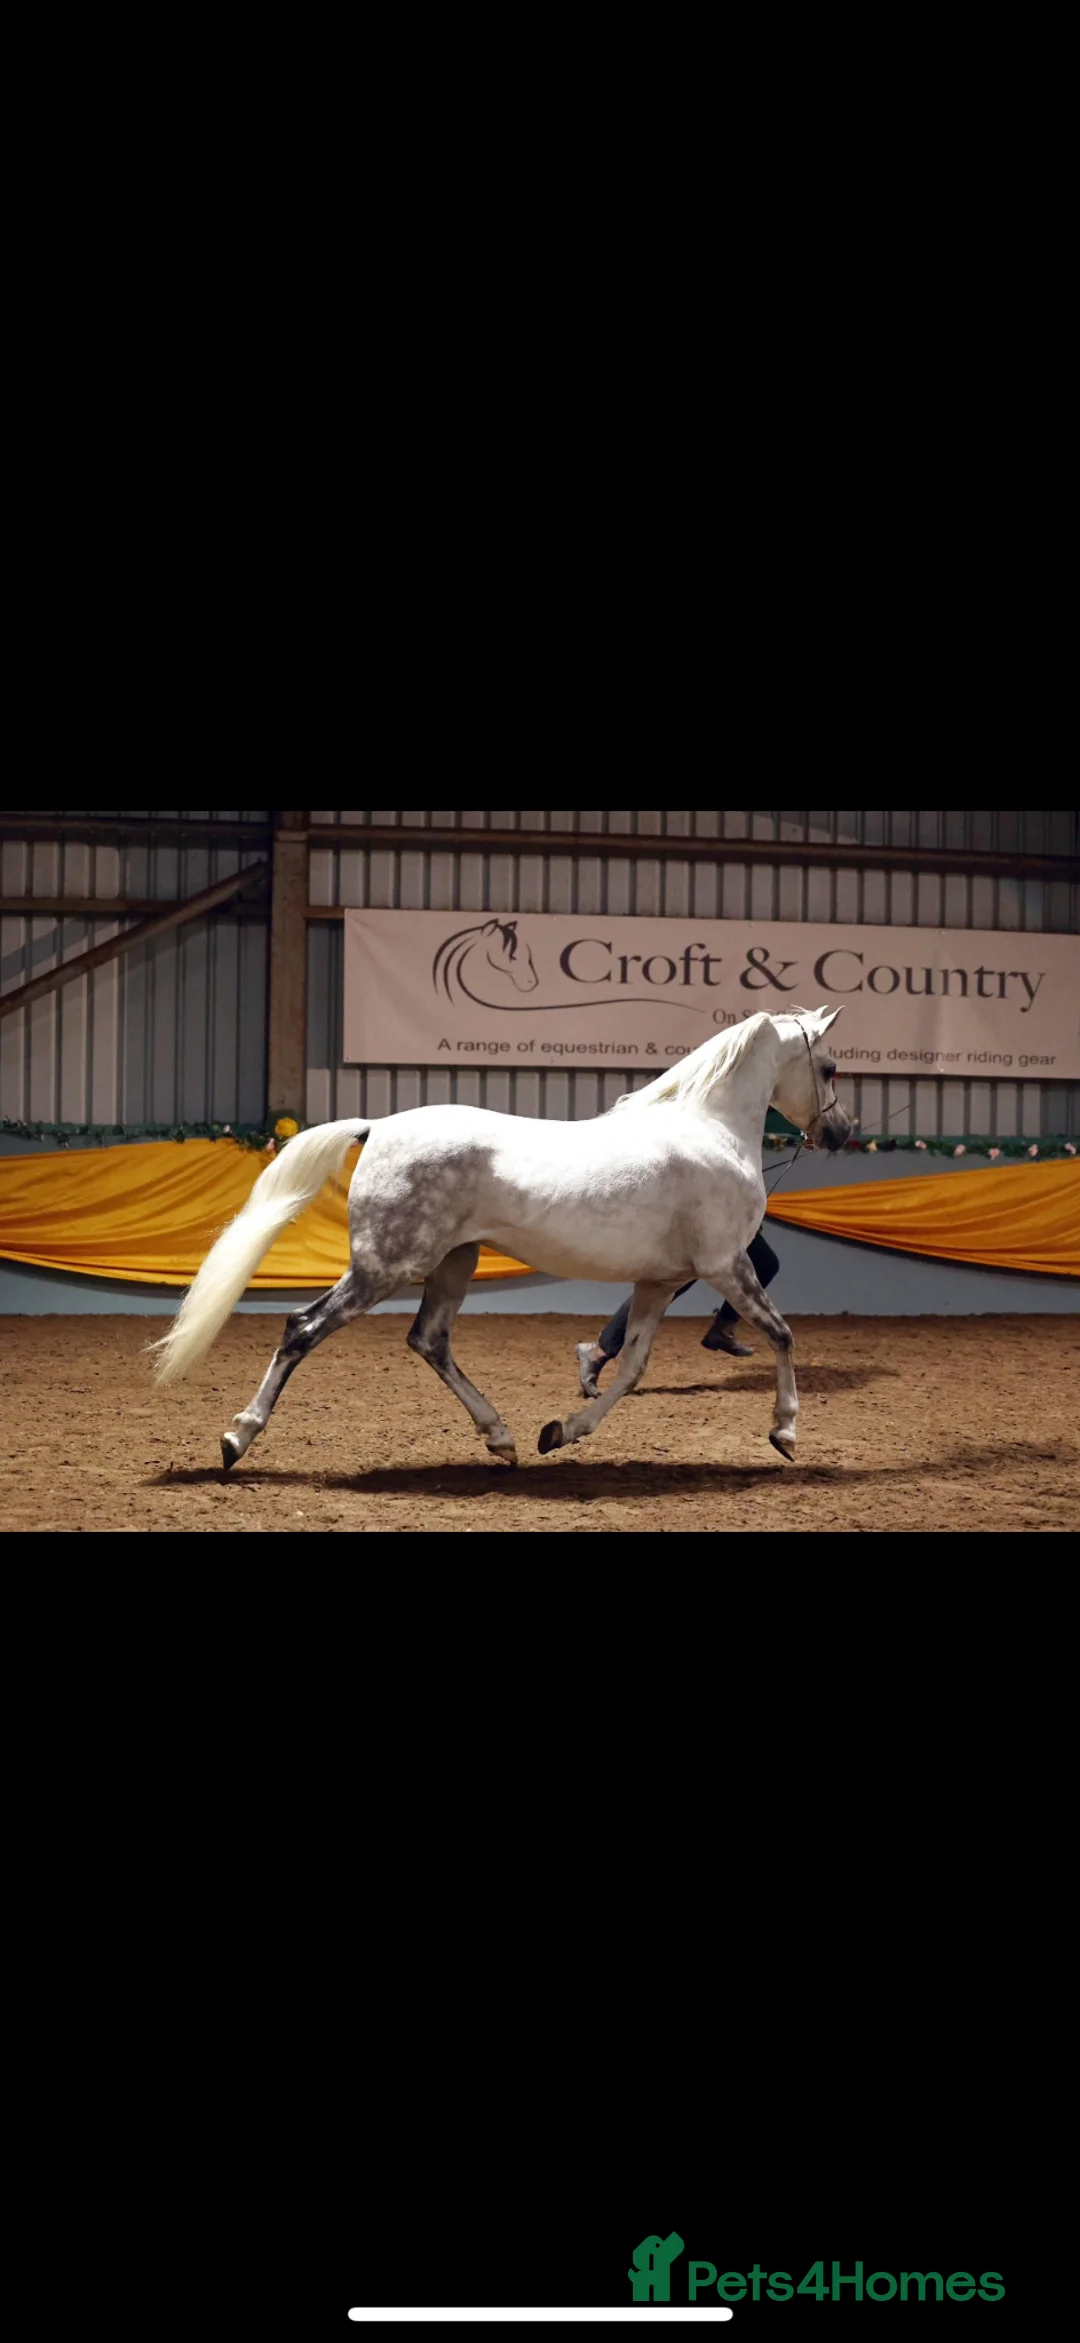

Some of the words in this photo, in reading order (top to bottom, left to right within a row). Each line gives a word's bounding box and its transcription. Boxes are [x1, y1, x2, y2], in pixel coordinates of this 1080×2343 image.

[559, 938, 724, 988] Croft
[738, 946, 799, 992] &
[812, 949, 1047, 1013] Country
[712, 1008, 738, 1025] On
[436, 1037, 452, 1051] A
[456, 1040, 511, 1056] range
[516, 1039, 536, 1052] of
[540, 1041, 639, 1056] equestrian
[645, 1042, 659, 1055] &
[828, 1046, 881, 1063] luding
[886, 1048, 962, 1066] designer
[965, 1050, 1013, 1067] riding
[1018, 1053, 1058, 1068] gear
